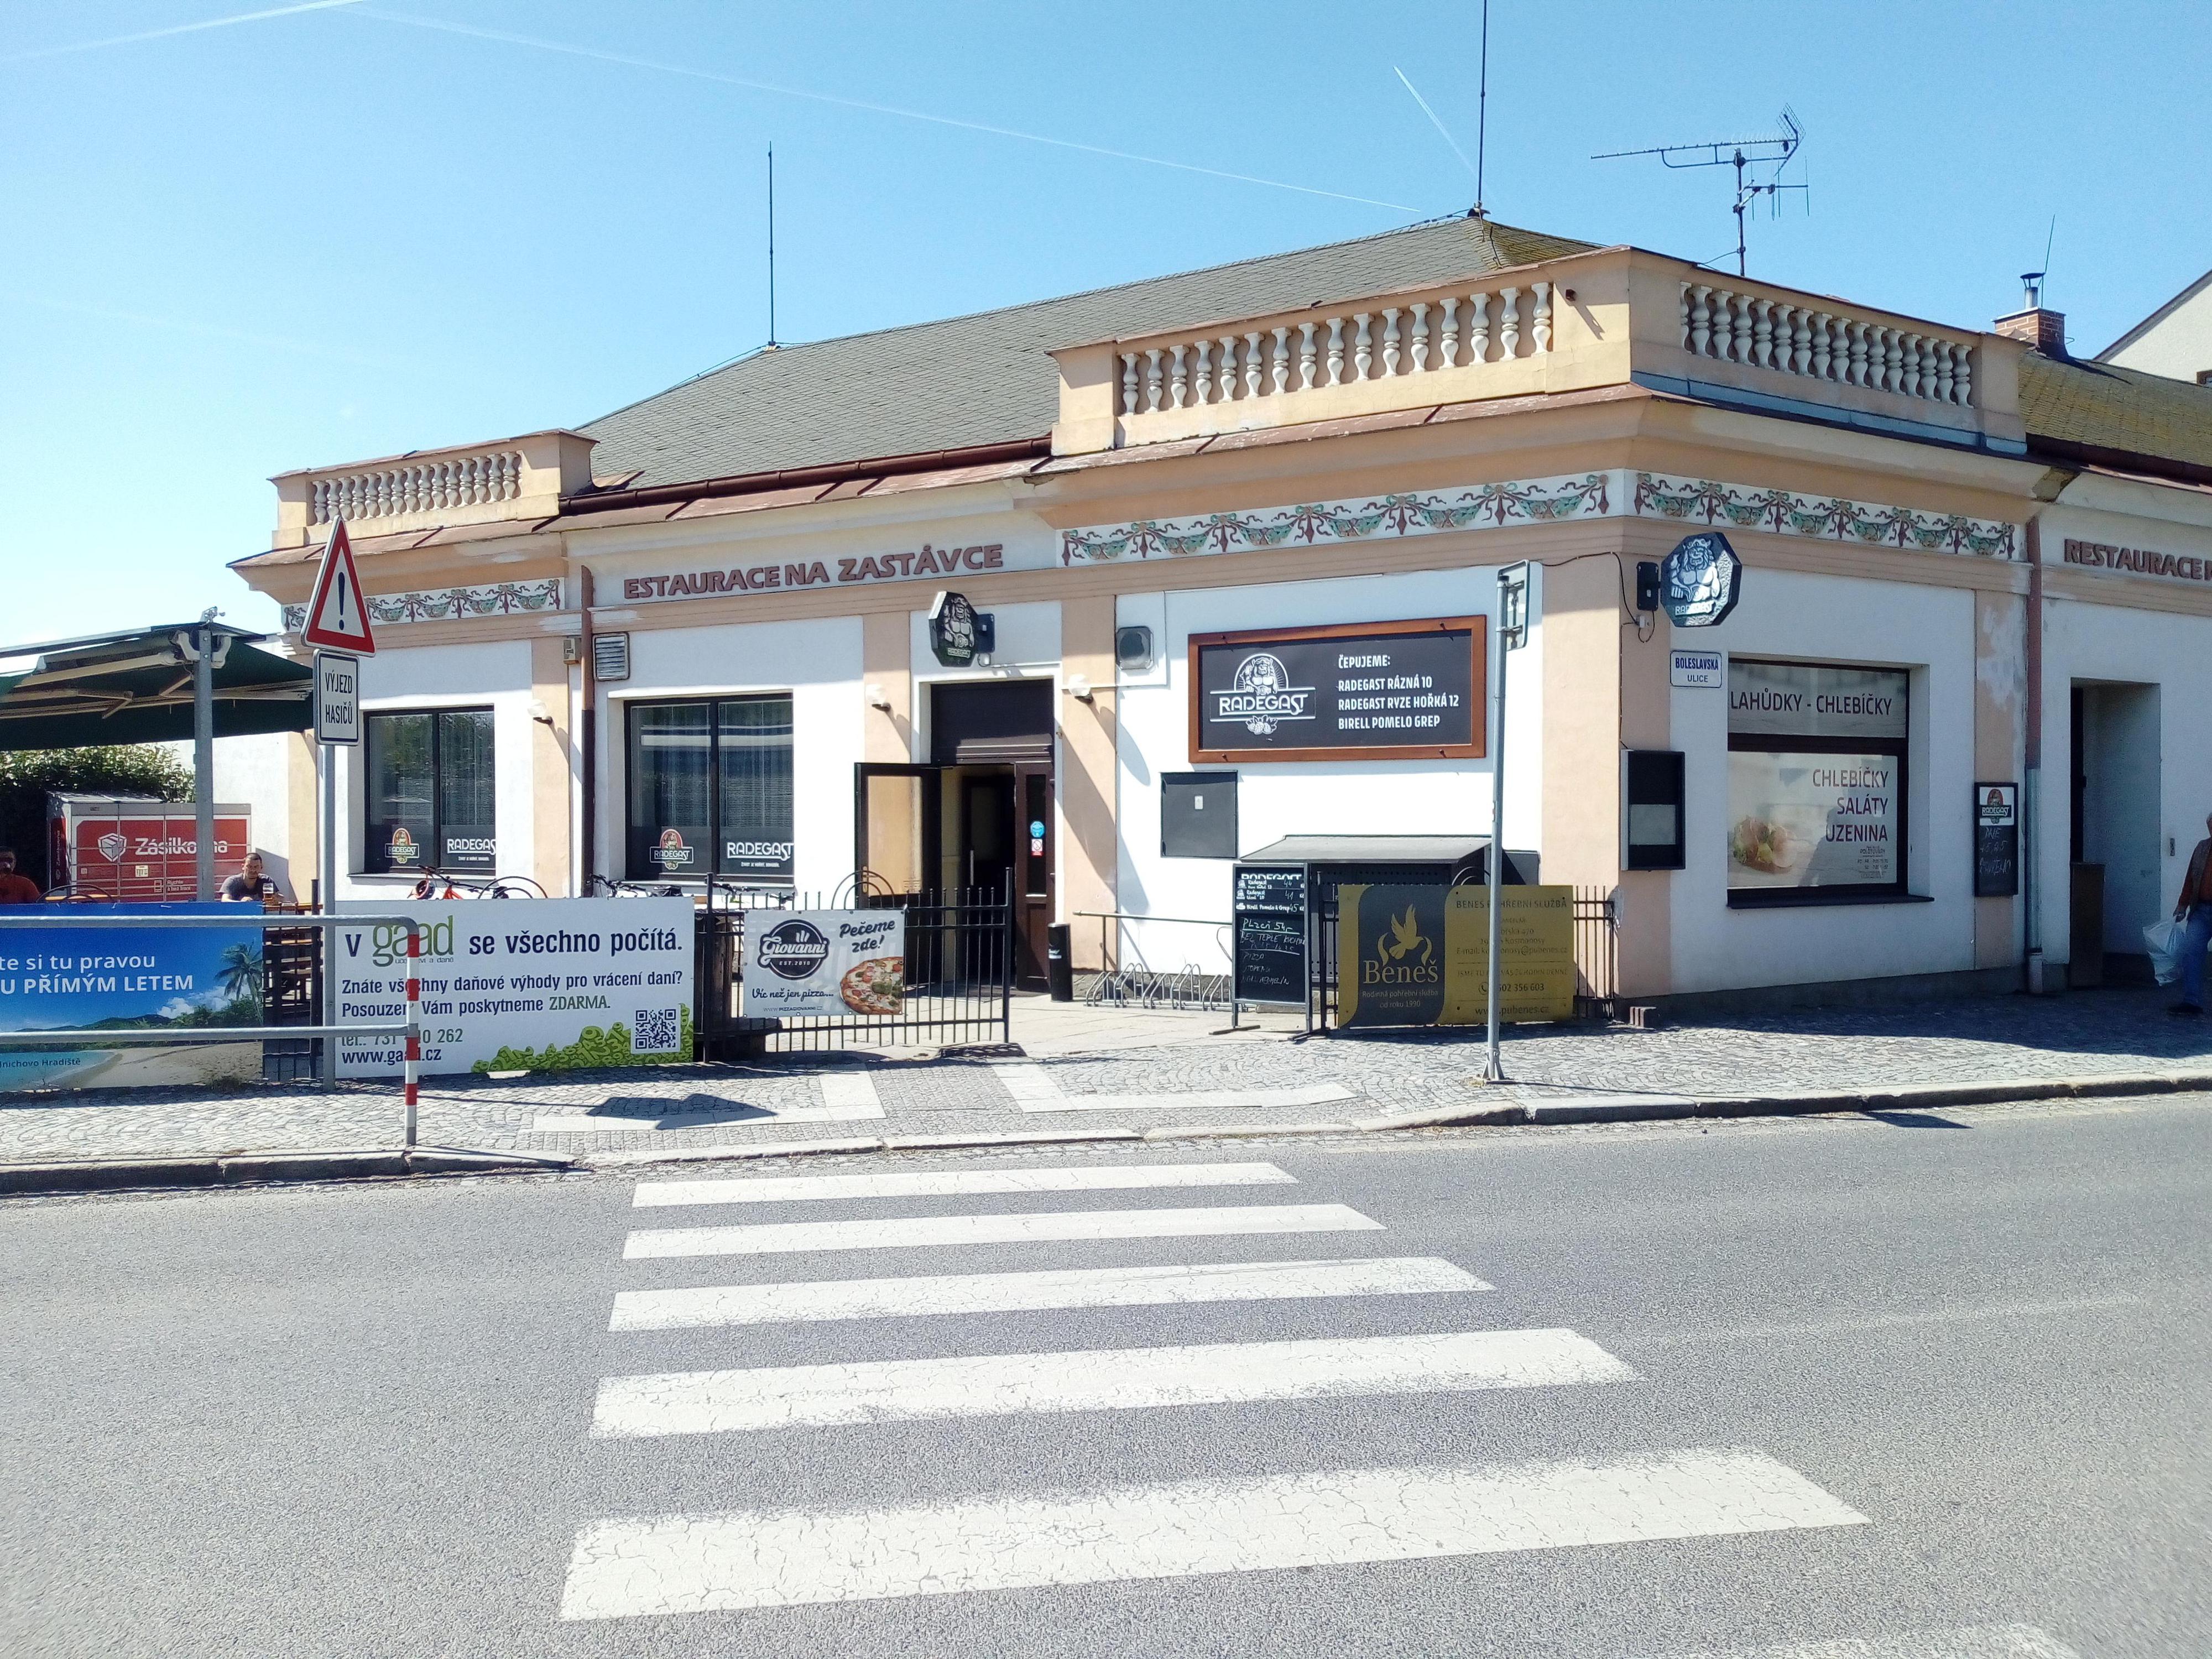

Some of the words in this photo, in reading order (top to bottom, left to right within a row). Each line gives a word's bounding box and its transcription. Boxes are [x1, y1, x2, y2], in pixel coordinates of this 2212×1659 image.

[2064, 539, 2202, 580] RESTAURACE
[623, 566, 780, 599] ESTAURACE
[784, 562, 830, 585] NA
[838, 544, 1003, 581] ZASTÁVCE
[1338, 654, 1391, 669] ČEPUJEME:
[1675, 656, 1719, 670] BOLESLAVSKÁ
[325, 669, 353, 694] VÝJEZD
[1338, 678, 1386, 692] RADEGAST
[1387, 674, 1420, 691] RÁZNÁ
[1421, 676, 1432, 688] 10
[1220, 693, 1308, 716] RADEGAST
[1338, 697, 1386, 711] RADEGAST
[1387, 696, 1411, 709] RYZE
[1413, 692, 1447, 708] HOŘKÁ
[1449, 695, 1459, 707] 12
[1730, 688, 1802, 712] LAHŮDKY
[1816, 693, 1892, 715] CHLEBÍČKY
[325, 701, 353, 724] HASIČŮ
[1338, 717, 1370, 730] BIRELL
[1372, 716, 1413, 729] POMELO
[1415, 715, 1440, 728] GREP
[1813, 766, 1889, 788] CHLEBÍČKY
[1837, 794, 1888, 815] SALÁTY
[1982, 806, 2010, 817] RADEGAST
[1825, 824, 1888, 842] UZENINA
[135, 837, 228, 855] Zásilkoa
[388, 846, 416, 855] RADEGAST
[447, 838, 496, 855] RADEGAS
[654, 850, 690, 860] RADEGAST
[727, 842, 794, 862] RADEGAST
[839, 920, 896, 938] Pečeme
[345, 934, 362, 957] V
[469, 935, 495, 955] se
[505, 929, 601, 954] všechno
[611, 927, 682, 957] počítá.
[761, 936, 828, 961] Giovanni
[852, 935, 885, 953] zde!
[26, 954, 43, 971] si
[50, 957, 72, 970] tu
[80, 956, 155, 973] pravou
[1363, 958, 1438, 984] Beneš
[24, 973, 116, 994] PŘÍMÝM
[124, 974, 193, 992] LETEM
[342, 978, 383, 994] Znáte
[388, 978, 448, 995] všhny
[454, 975, 504, 992] daňové
[510, 974, 560, 992] výhody
[566, 975, 587, 990] pro
[593, 972, 642, 987] vrácení
[648, 970, 682, 985] daní?
[752, 987, 768, 999] Víc
[769, 988, 785, 998] než
[784, 990, 800, 1002] jen
[421, 999, 452, 1015] Vám
[459, 997, 543, 1016] poskytneme
[549, 995, 611, 1011] ZDARMA.
[437, 1028, 463, 1043] 262
[41, 1057, 81, 1066] Hradiště
[342, 1047, 442, 1066] www.ga.cz
